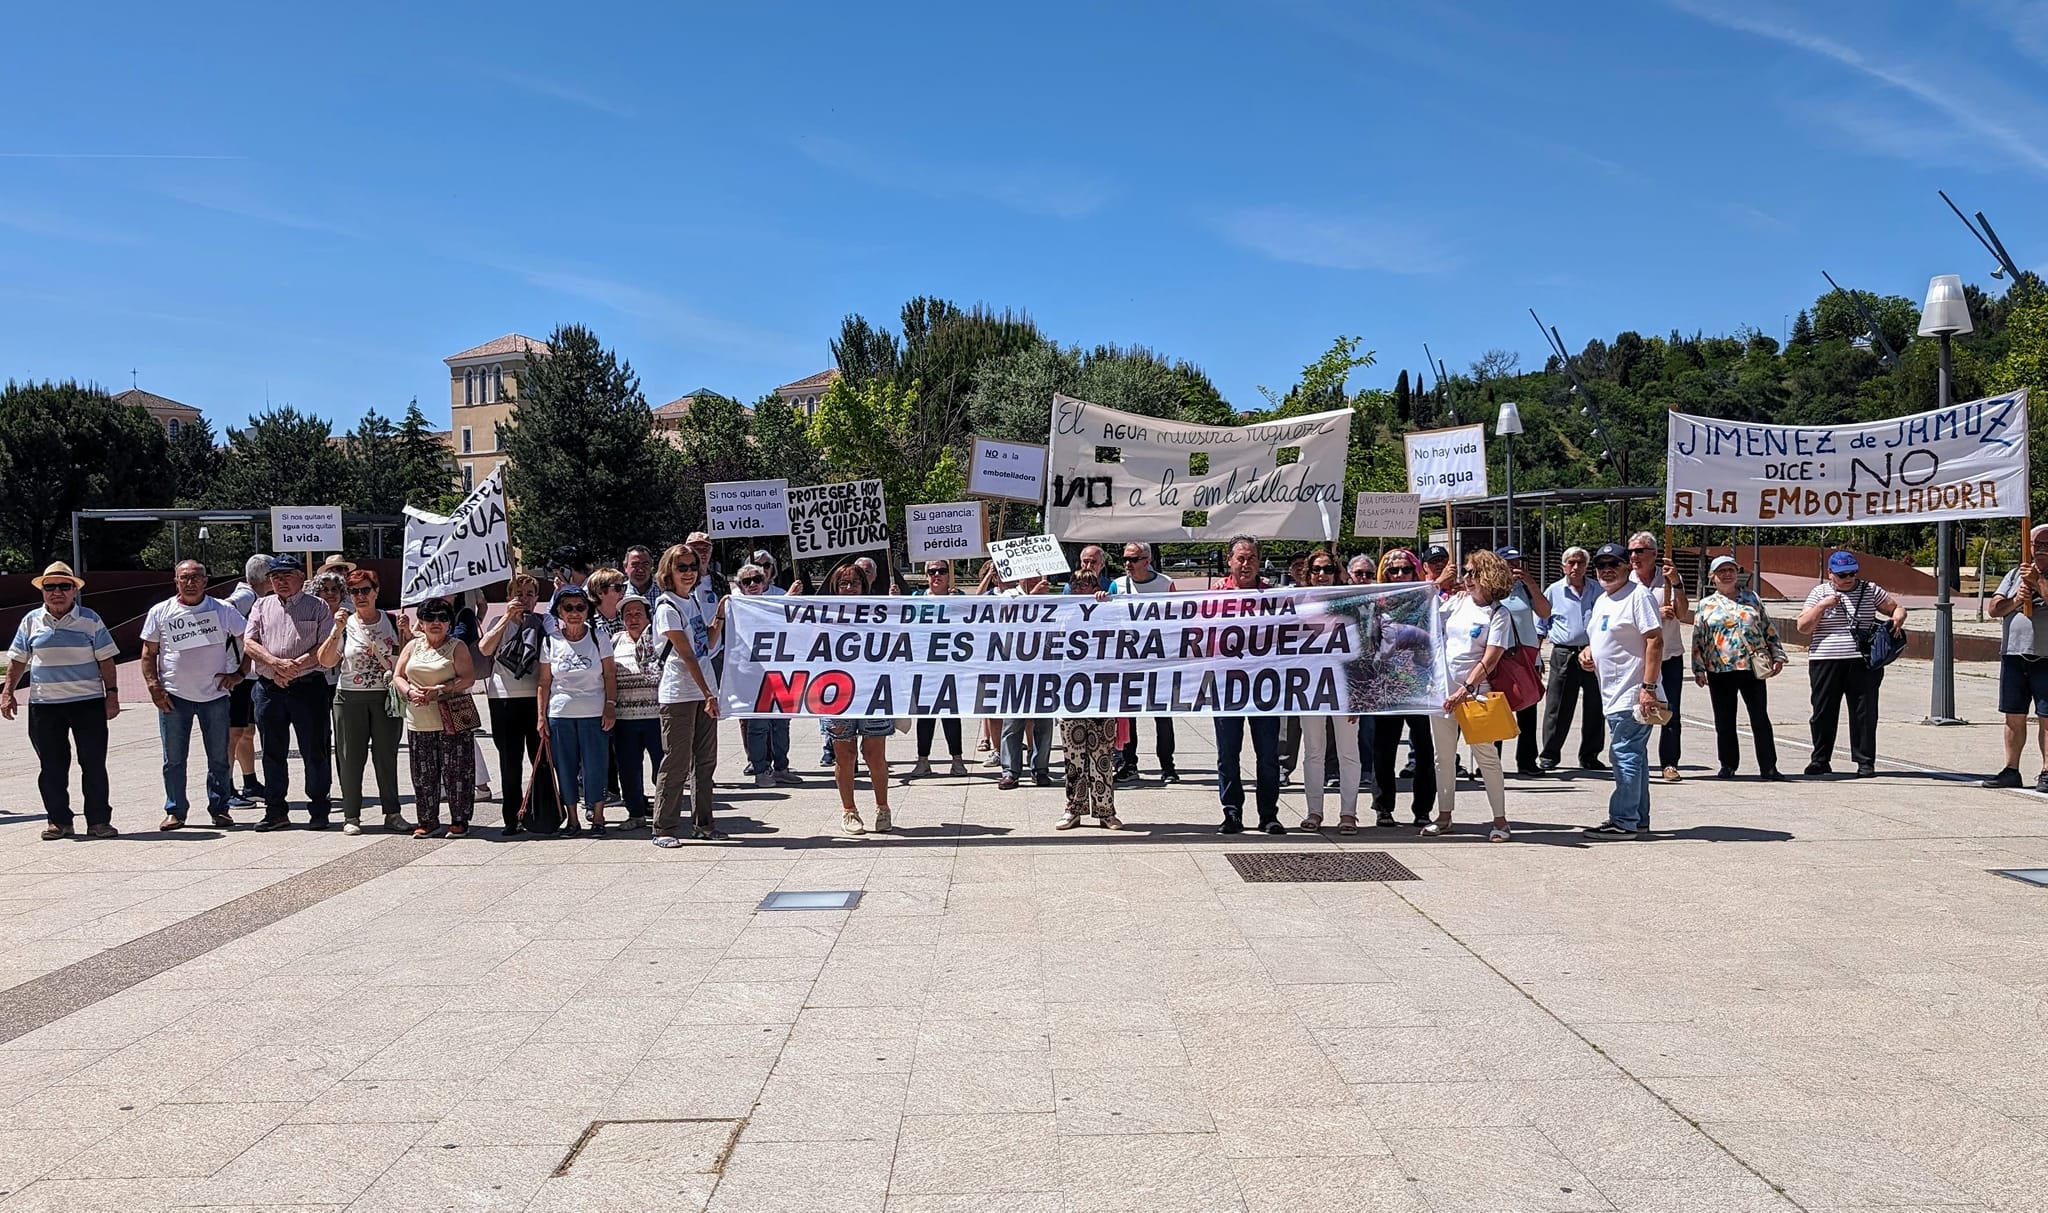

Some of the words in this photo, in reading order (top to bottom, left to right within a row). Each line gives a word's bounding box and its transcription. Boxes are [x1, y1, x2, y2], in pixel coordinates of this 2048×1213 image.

[1057, 401, 1086, 436] El
[1103, 422, 1147, 441] AGUA
[1157, 430, 1241, 446] nuestra
[1247, 421, 1335, 456] riqueza
[1677, 424, 1836, 456] JIMENEZ
[1850, 431, 1876, 449] de
[1885, 399, 2015, 447] JAMUZ
[985, 449, 998, 458] NO
[1012, 452, 1019, 460] la
[1415, 449, 1429, 459] No
[1432, 447, 1450, 459] hay
[1453, 443, 1477, 454] vida
[983, 469, 1036, 481] embotelladora
[1765, 461, 1826, 480] DICE:
[1848, 449, 1939, 492] NO
[1053, 475, 1112, 507] NO
[1129, 487, 1145, 508] a
[1158, 468, 1179, 507] la
[1193, 464, 1342, 507] embotelladora
[1417, 473, 1435, 486] sin
[1439, 471, 1473, 486] agua
[709, 491, 719, 499] Si
[721, 491, 737, 499] nos
[740, 489, 766, 500] quitan
[769, 488, 777, 497] el
[788, 483, 857, 504] PROTEGER
[861, 482, 880, 497] HOY
[1673, 491, 1692, 519] A
[1707, 489, 1738, 513] LA
[1759, 480, 1999, 520] EMBOTELLADORA
[710, 504, 733, 514] agua
[737, 503, 752, 511] nos
[755, 502, 782, 513] quitan
[788, 505, 805, 522] UN
[808, 497, 881, 519] ACUIFERO
[913, 510, 927, 521] Su
[929, 508, 975, 520] ganancia:
[453, 502, 505, 540] GUA
[712, 519, 724, 530] la
[730, 517, 764, 530] vida.
[791, 520, 815, 535] ES
[822, 511, 880, 531] CUIDAR
[1358, 520, 1378, 529] VALLE
[1382, 521, 1415, 529] JAMUZ
[927, 524, 963, 534] nuestra
[283, 534, 293, 542] la
[296, 533, 322, 542] vida.
[797, 534, 821, 552] EL
[828, 523, 888, 549] FUTURO
[924, 538, 968, 551] pérdida
[991, 544, 1003, 552] EL
[1005, 544, 1052, 558] DERECHO
[467, 559, 487, 576] EN
[997, 559, 1010, 568] NO
[999, 567, 1012, 579] NO
[784, 604, 888, 624] VALLES
[900, 604, 950, 624] DEL
[963, 603, 1059, 623] JAMUZ
[1080, 603, 1099, 622] Y
[1128, 597, 1297, 622] VALDUERNA
[169, 618, 185, 631] NO
[750, 631, 795, 662] EL
[806, 631, 914, 662] AGUA
[927, 631, 974, 662] ES
[986, 629, 1166, 662] NUESTRA
[1179, 623, 1351, 659] RIQUEZA
[753, 669, 856, 716] NO
[866, 674, 893, 715] A
[908, 674, 960, 715] LA
[973, 667, 1340, 714] EMBOTELLADORA
